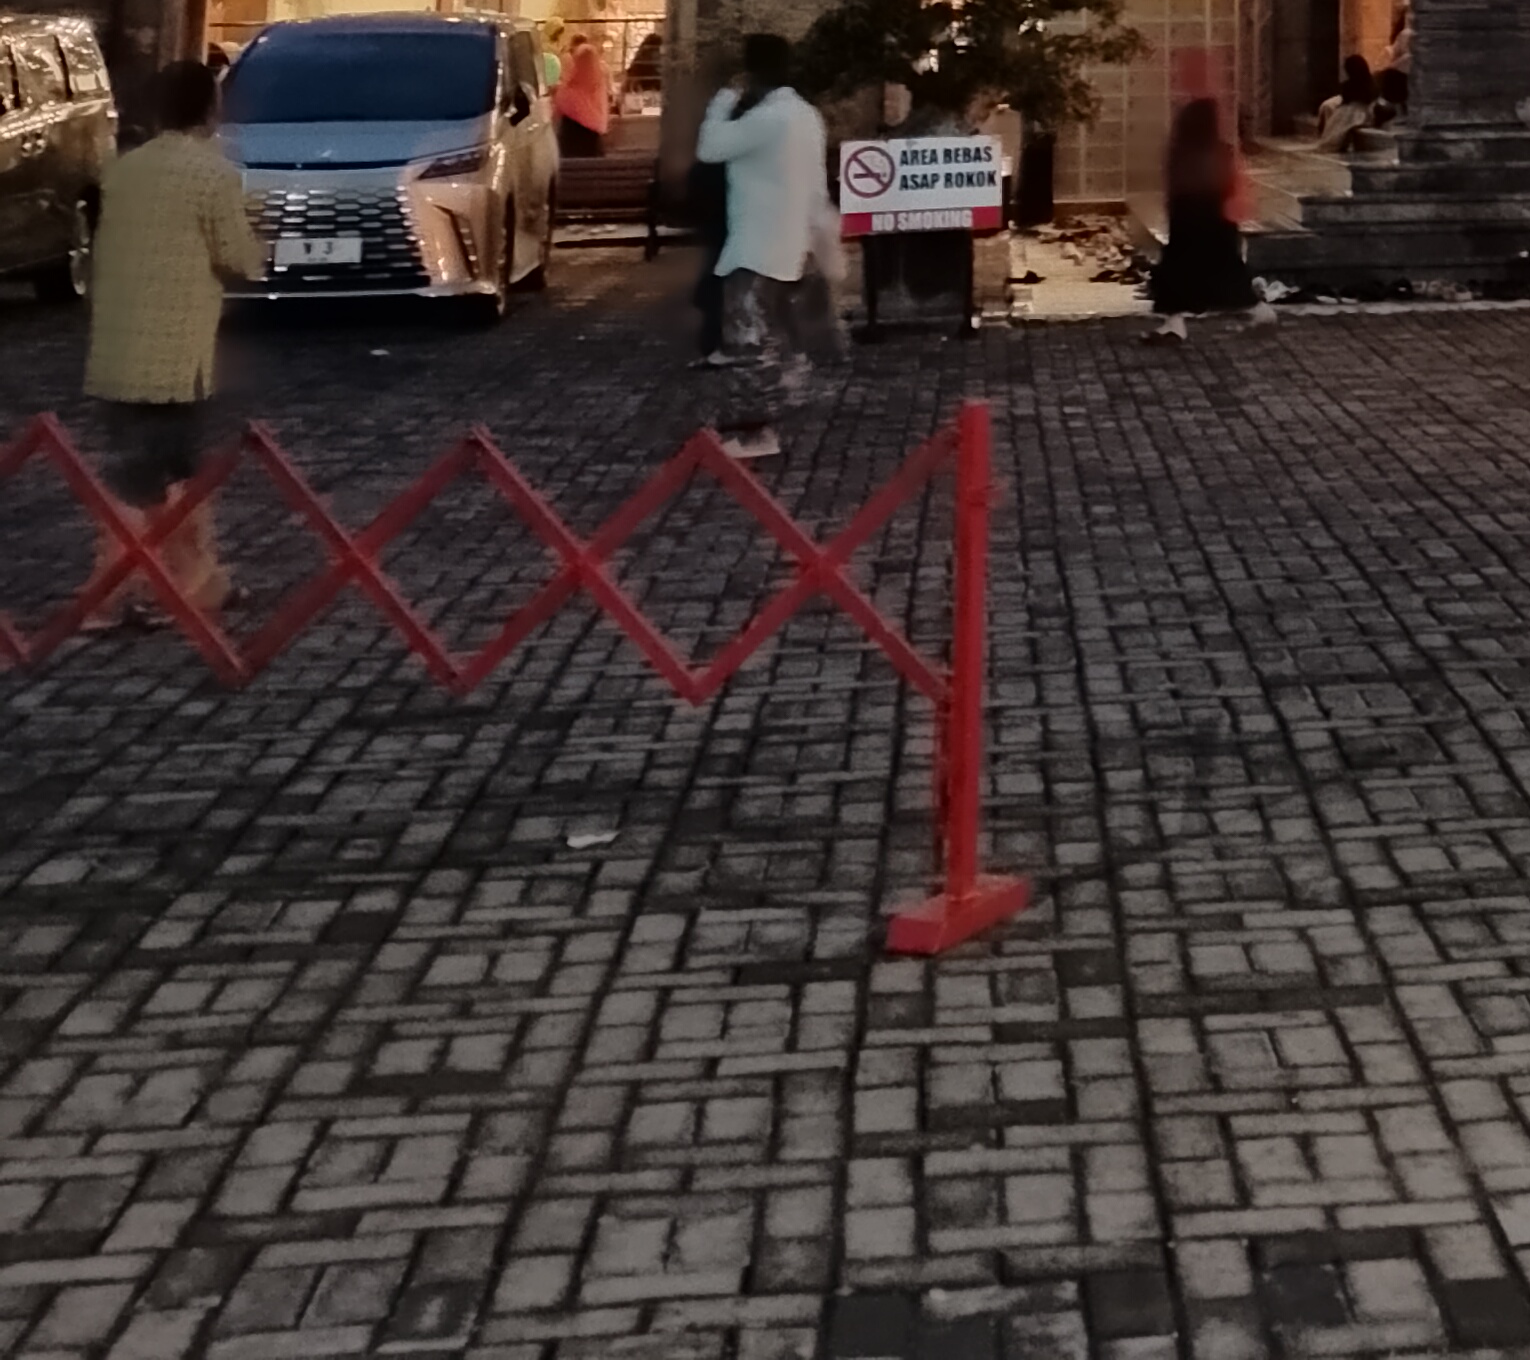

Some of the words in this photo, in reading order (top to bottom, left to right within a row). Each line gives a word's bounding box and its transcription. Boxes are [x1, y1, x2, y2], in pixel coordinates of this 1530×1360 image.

[899, 148, 939, 167] AREA
[942, 146, 993, 165] BEBAS
[898, 173, 940, 191] ASAP
[943, 170, 997, 189] ROKOK
[872, 213, 895, 231] NO
[897, 209, 973, 230] SMOKING
